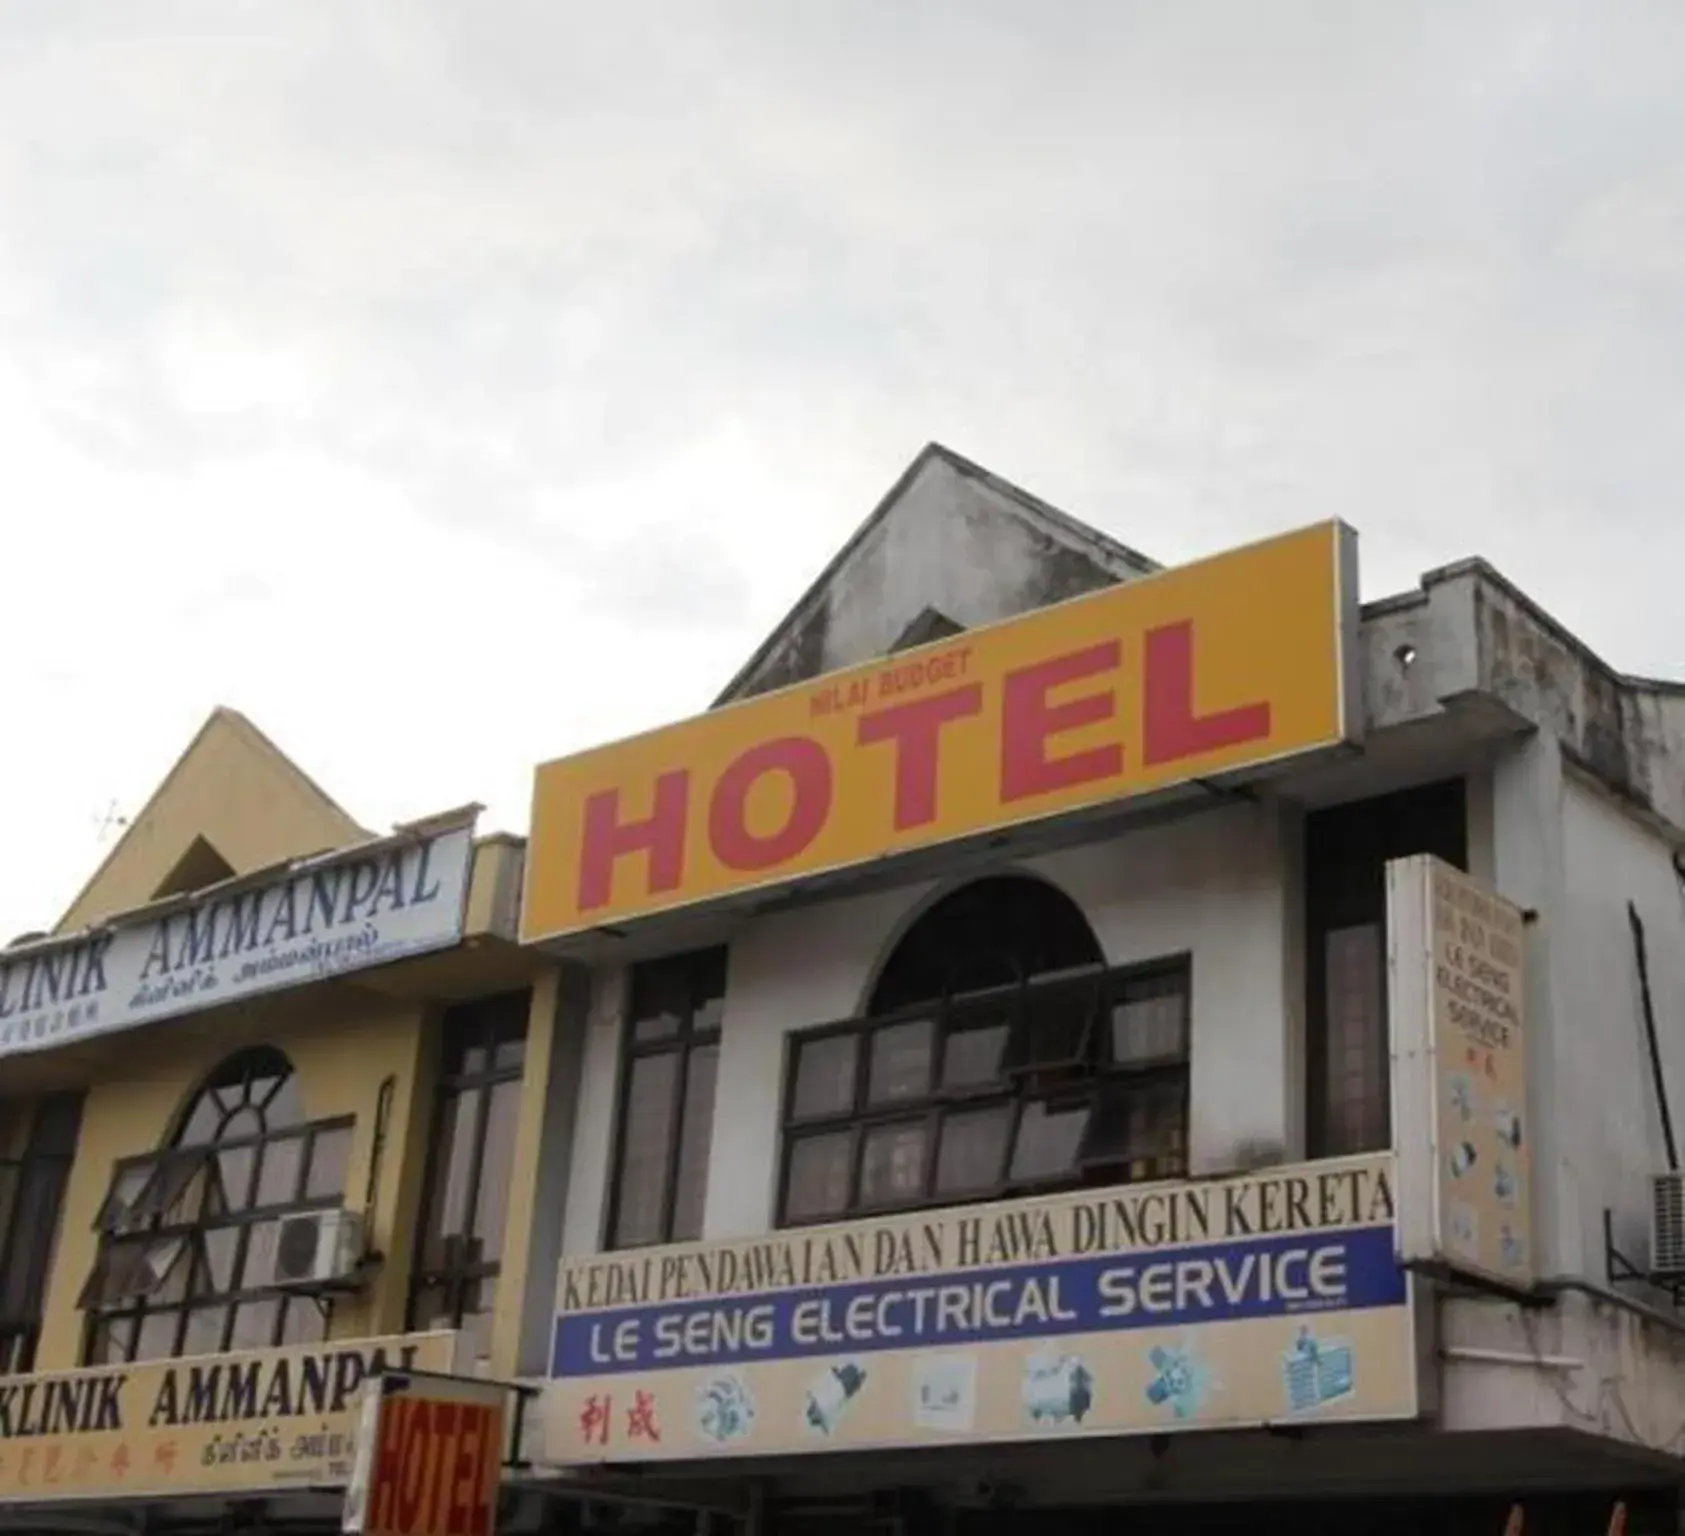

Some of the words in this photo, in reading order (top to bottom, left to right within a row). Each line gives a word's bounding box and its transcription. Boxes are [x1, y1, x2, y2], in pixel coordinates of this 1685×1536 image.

[878, 647, 972, 698] BUDGET
[577, 619, 1271, 911] HOTEL
[140, 838, 441, 980] AMMANPAL
[563, 1255, 652, 1311] KEDAI
[873, 1222, 945, 1278] DAN
[958, 1209, 1058, 1268] HAWA
[1072, 1189, 1213, 1255] DINGIN
[1223, 1168, 1396, 1237] KERETA
[589, 1319, 641, 1364] LE
[653, 1302, 776, 1359] SENG
[790, 1276, 1078, 1344] ELECTRICAL
[1098, 1245, 1348, 1317] SERVICE
[0, 1374, 128, 1437] KLINIK
[370, 1400, 492, 1535] HOTEL
